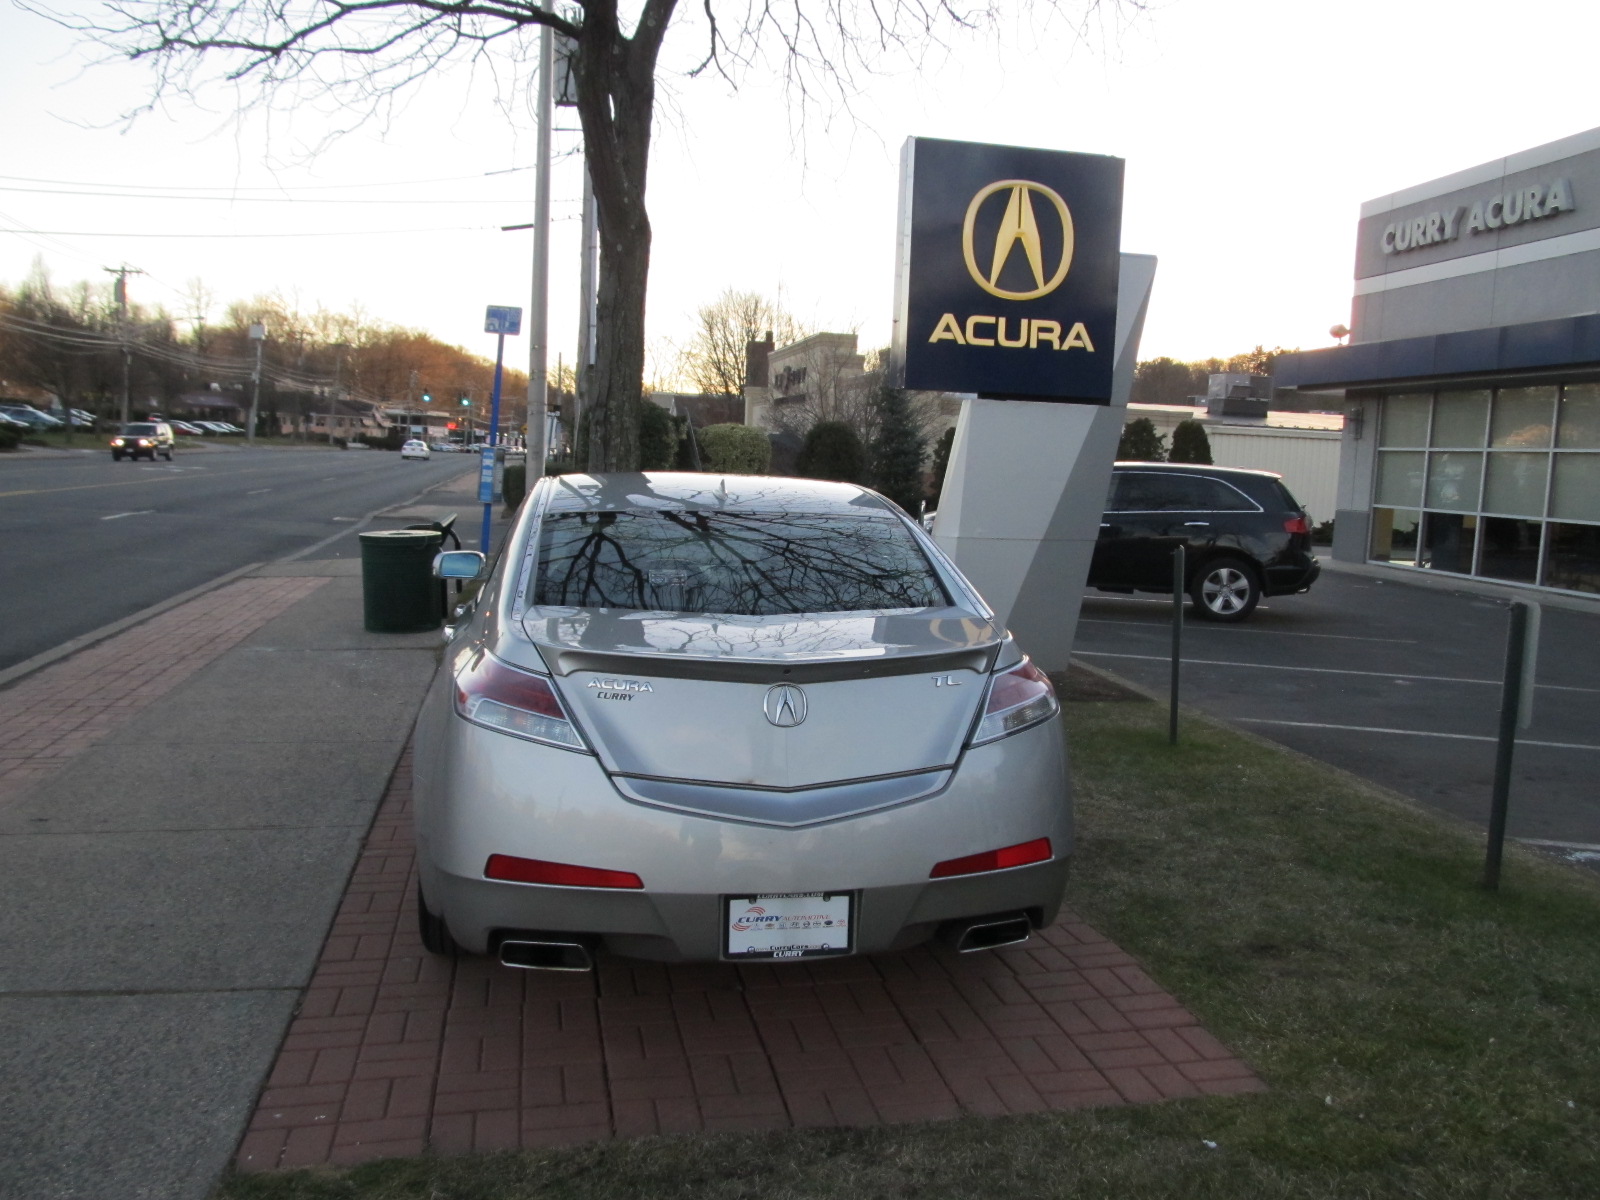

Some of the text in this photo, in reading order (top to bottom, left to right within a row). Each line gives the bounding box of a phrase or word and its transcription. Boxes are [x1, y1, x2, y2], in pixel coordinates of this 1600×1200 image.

[1380, 178, 1575, 254] CURRY ACURA
[928, 313, 1095, 352] ACURA
[586, 677, 654, 693] ACURA
[931, 675, 963, 687] TL
[597, 691, 636, 702] CURRY
[737, 915, 783, 924] CURRY
[773, 950, 805, 958] CURRY
